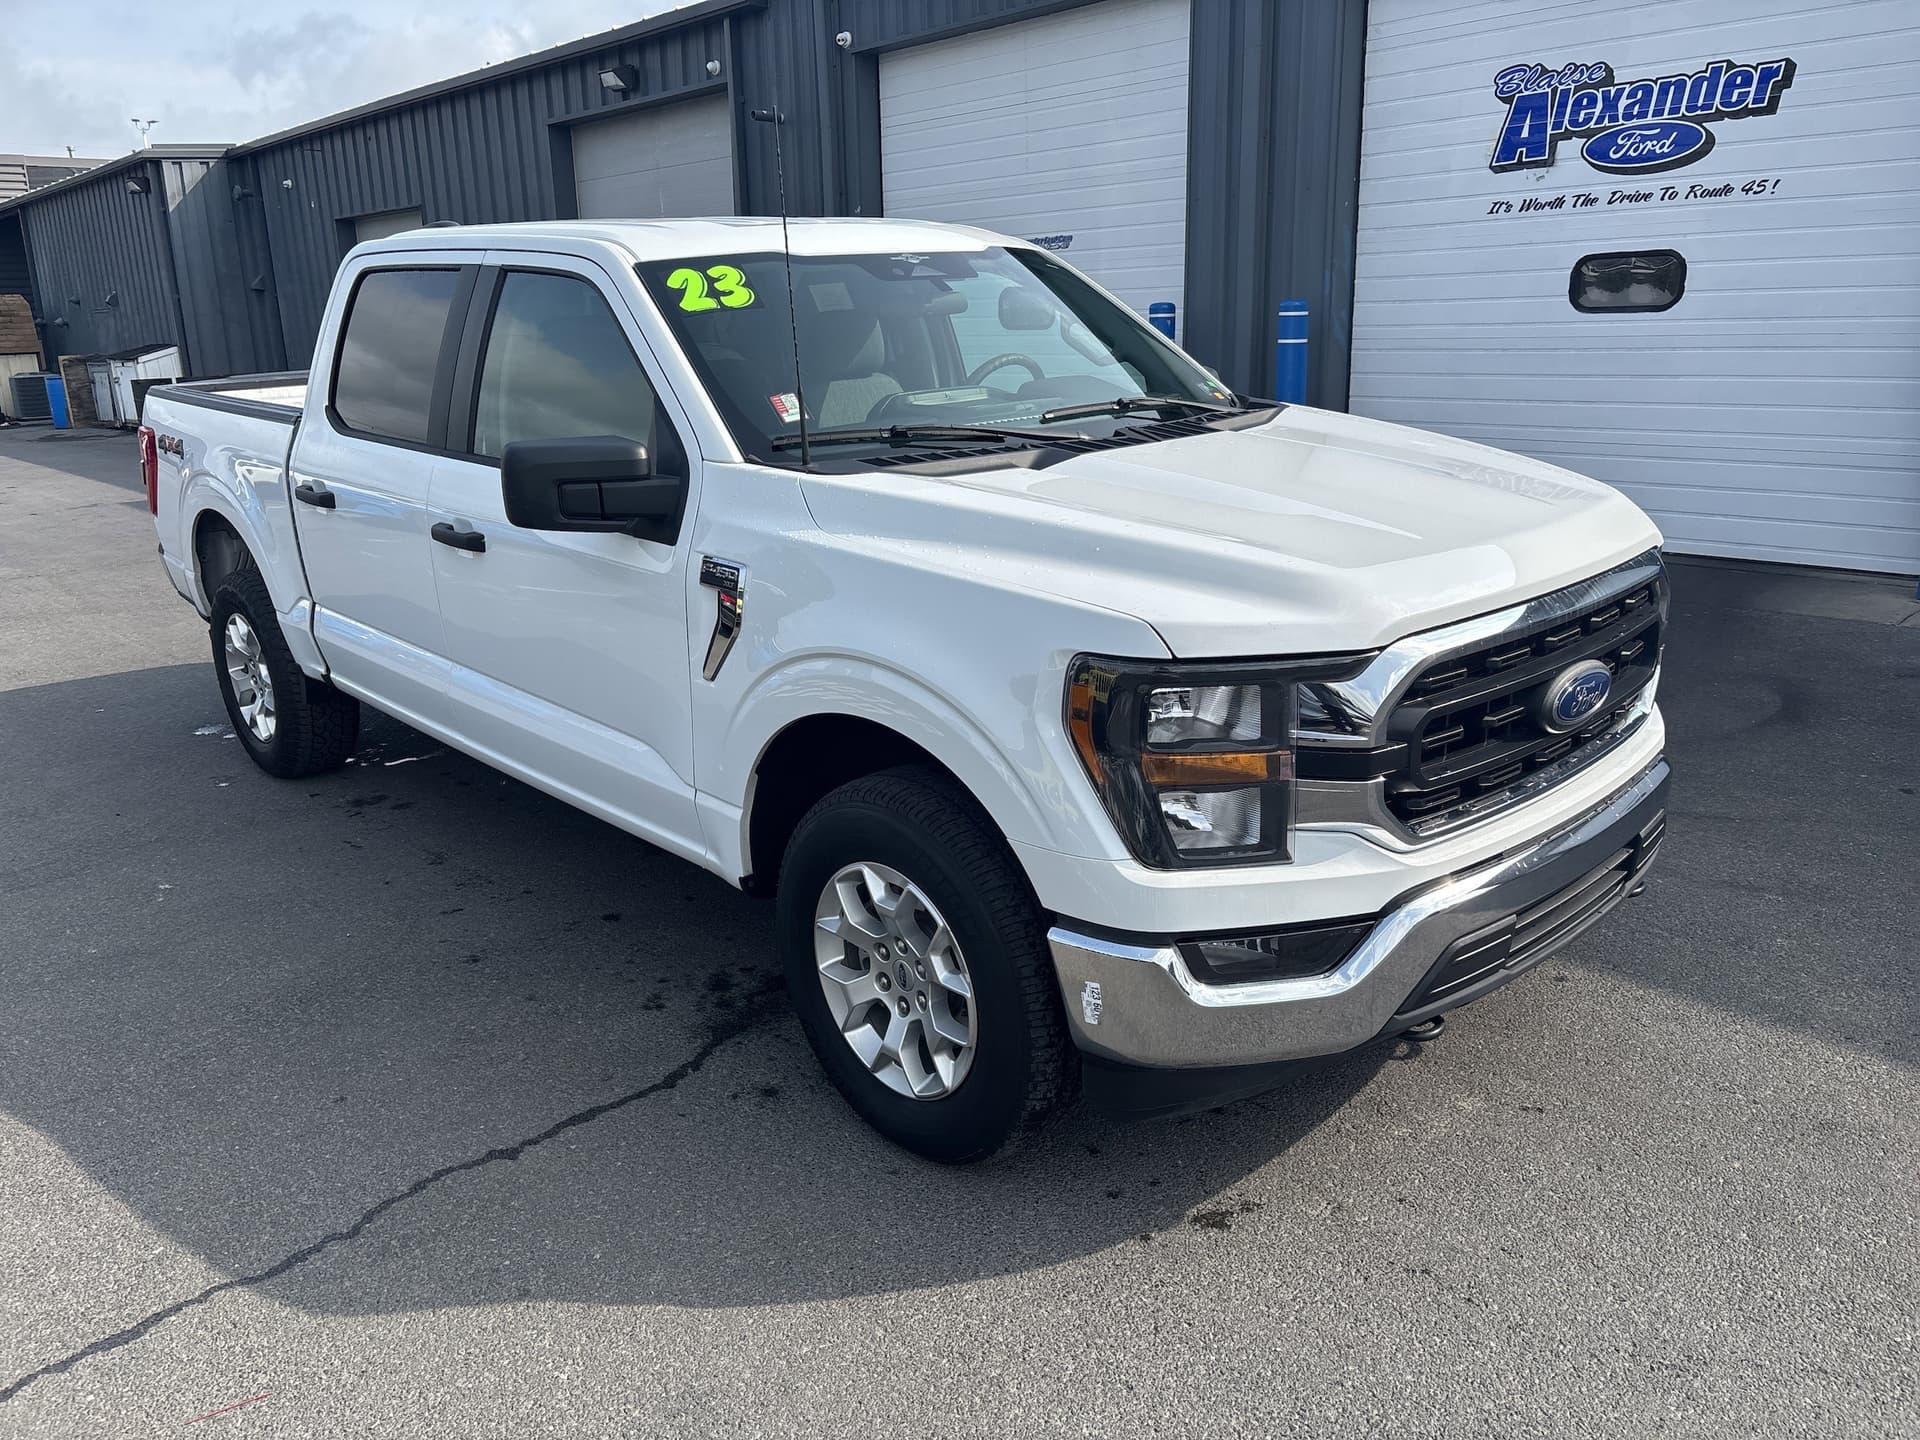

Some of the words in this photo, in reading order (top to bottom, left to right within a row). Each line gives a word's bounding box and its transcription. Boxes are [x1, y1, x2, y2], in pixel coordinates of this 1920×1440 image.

[1495, 61, 1608, 97] Blaise
[1491, 59, 1792, 168] Alexander
[1608, 127, 1676, 160] Ford
[1487, 199, 1513, 215] It's
[1518, 194, 1566, 214] Worth
[1572, 191, 1600, 209] The
[1607, 187, 1654, 206] Drive
[1659, 185, 1680, 202] To
[1687, 181, 1735, 199] Route
[666, 264, 756, 313] 23
[1571, 680, 1603, 716] Ford
